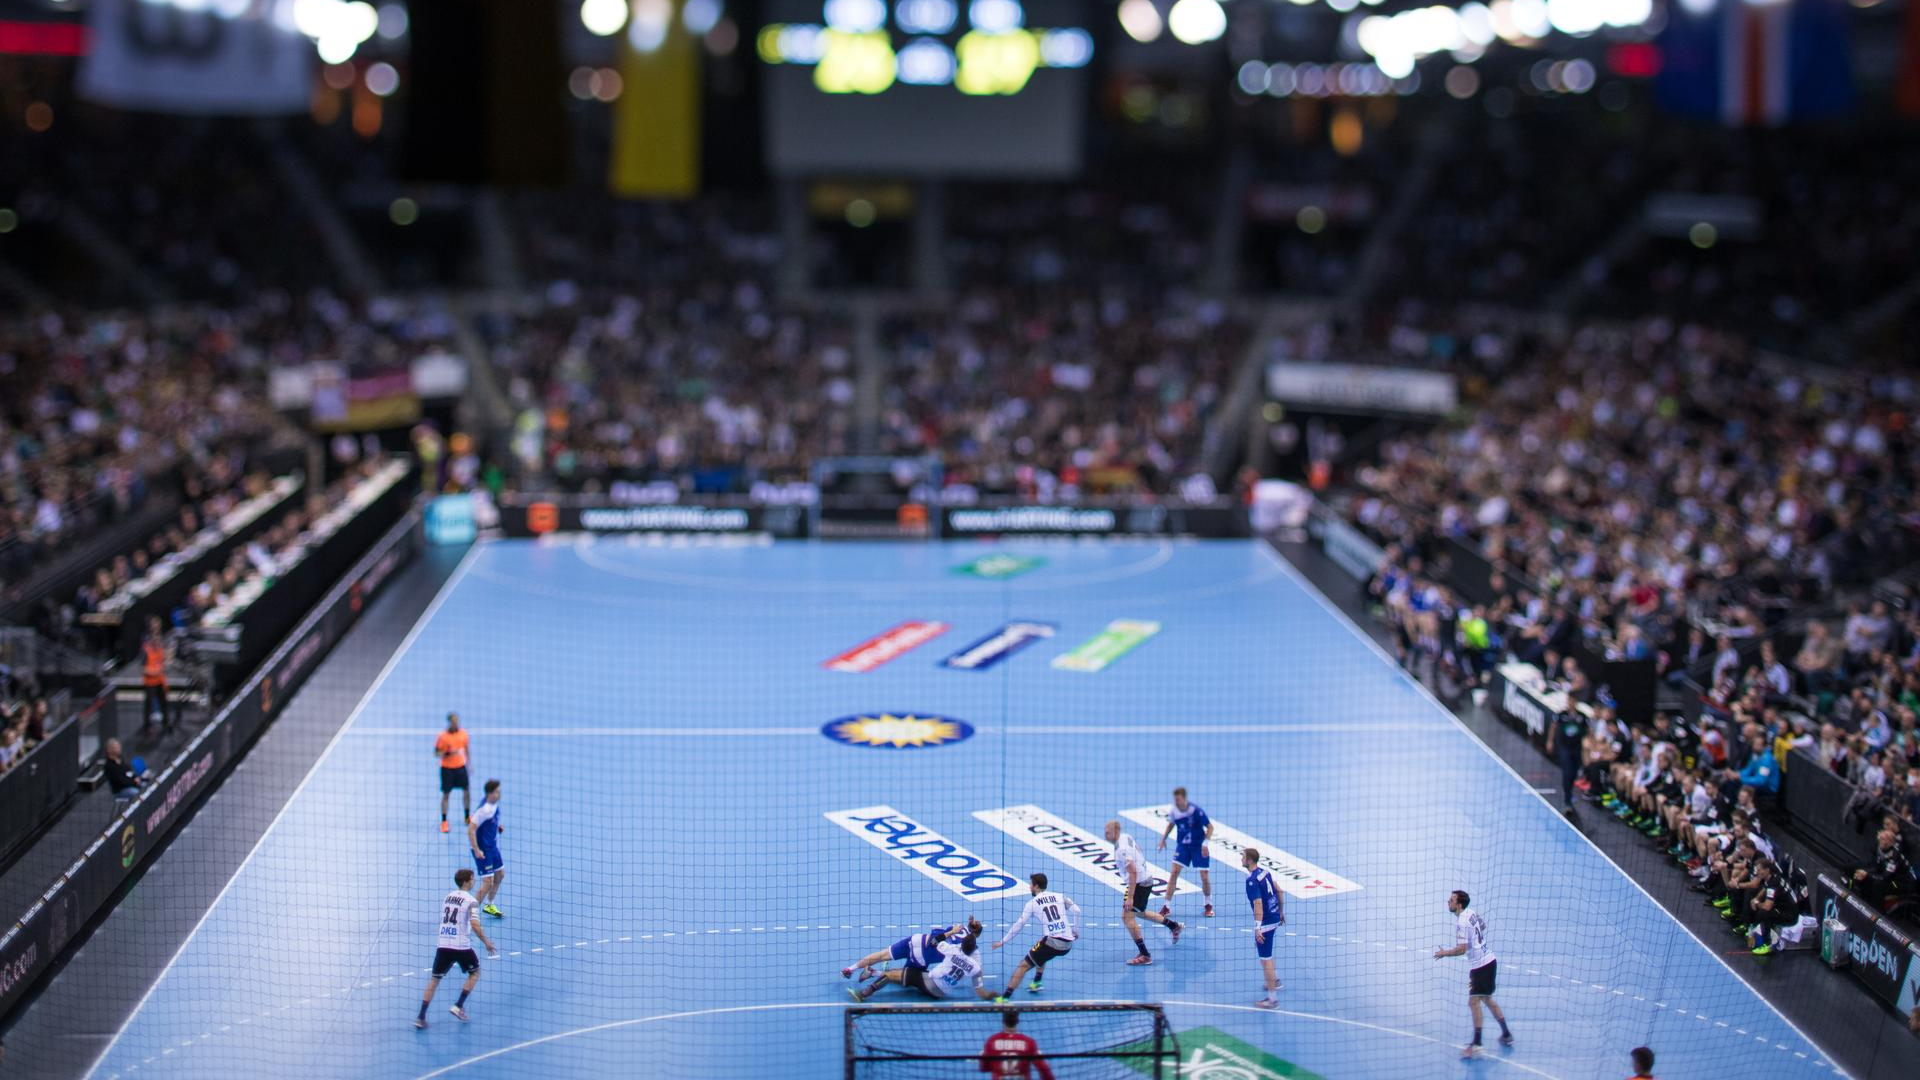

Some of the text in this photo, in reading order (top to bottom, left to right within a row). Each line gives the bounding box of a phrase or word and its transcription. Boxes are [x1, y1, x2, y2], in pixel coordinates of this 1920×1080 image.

[847, 815, 1018, 896] brother
[443, 907, 458, 925] 34
[1043, 905, 1061, 922] 10
[440, 926, 457, 935] DKB
[1048, 921, 1066, 932] DKB
